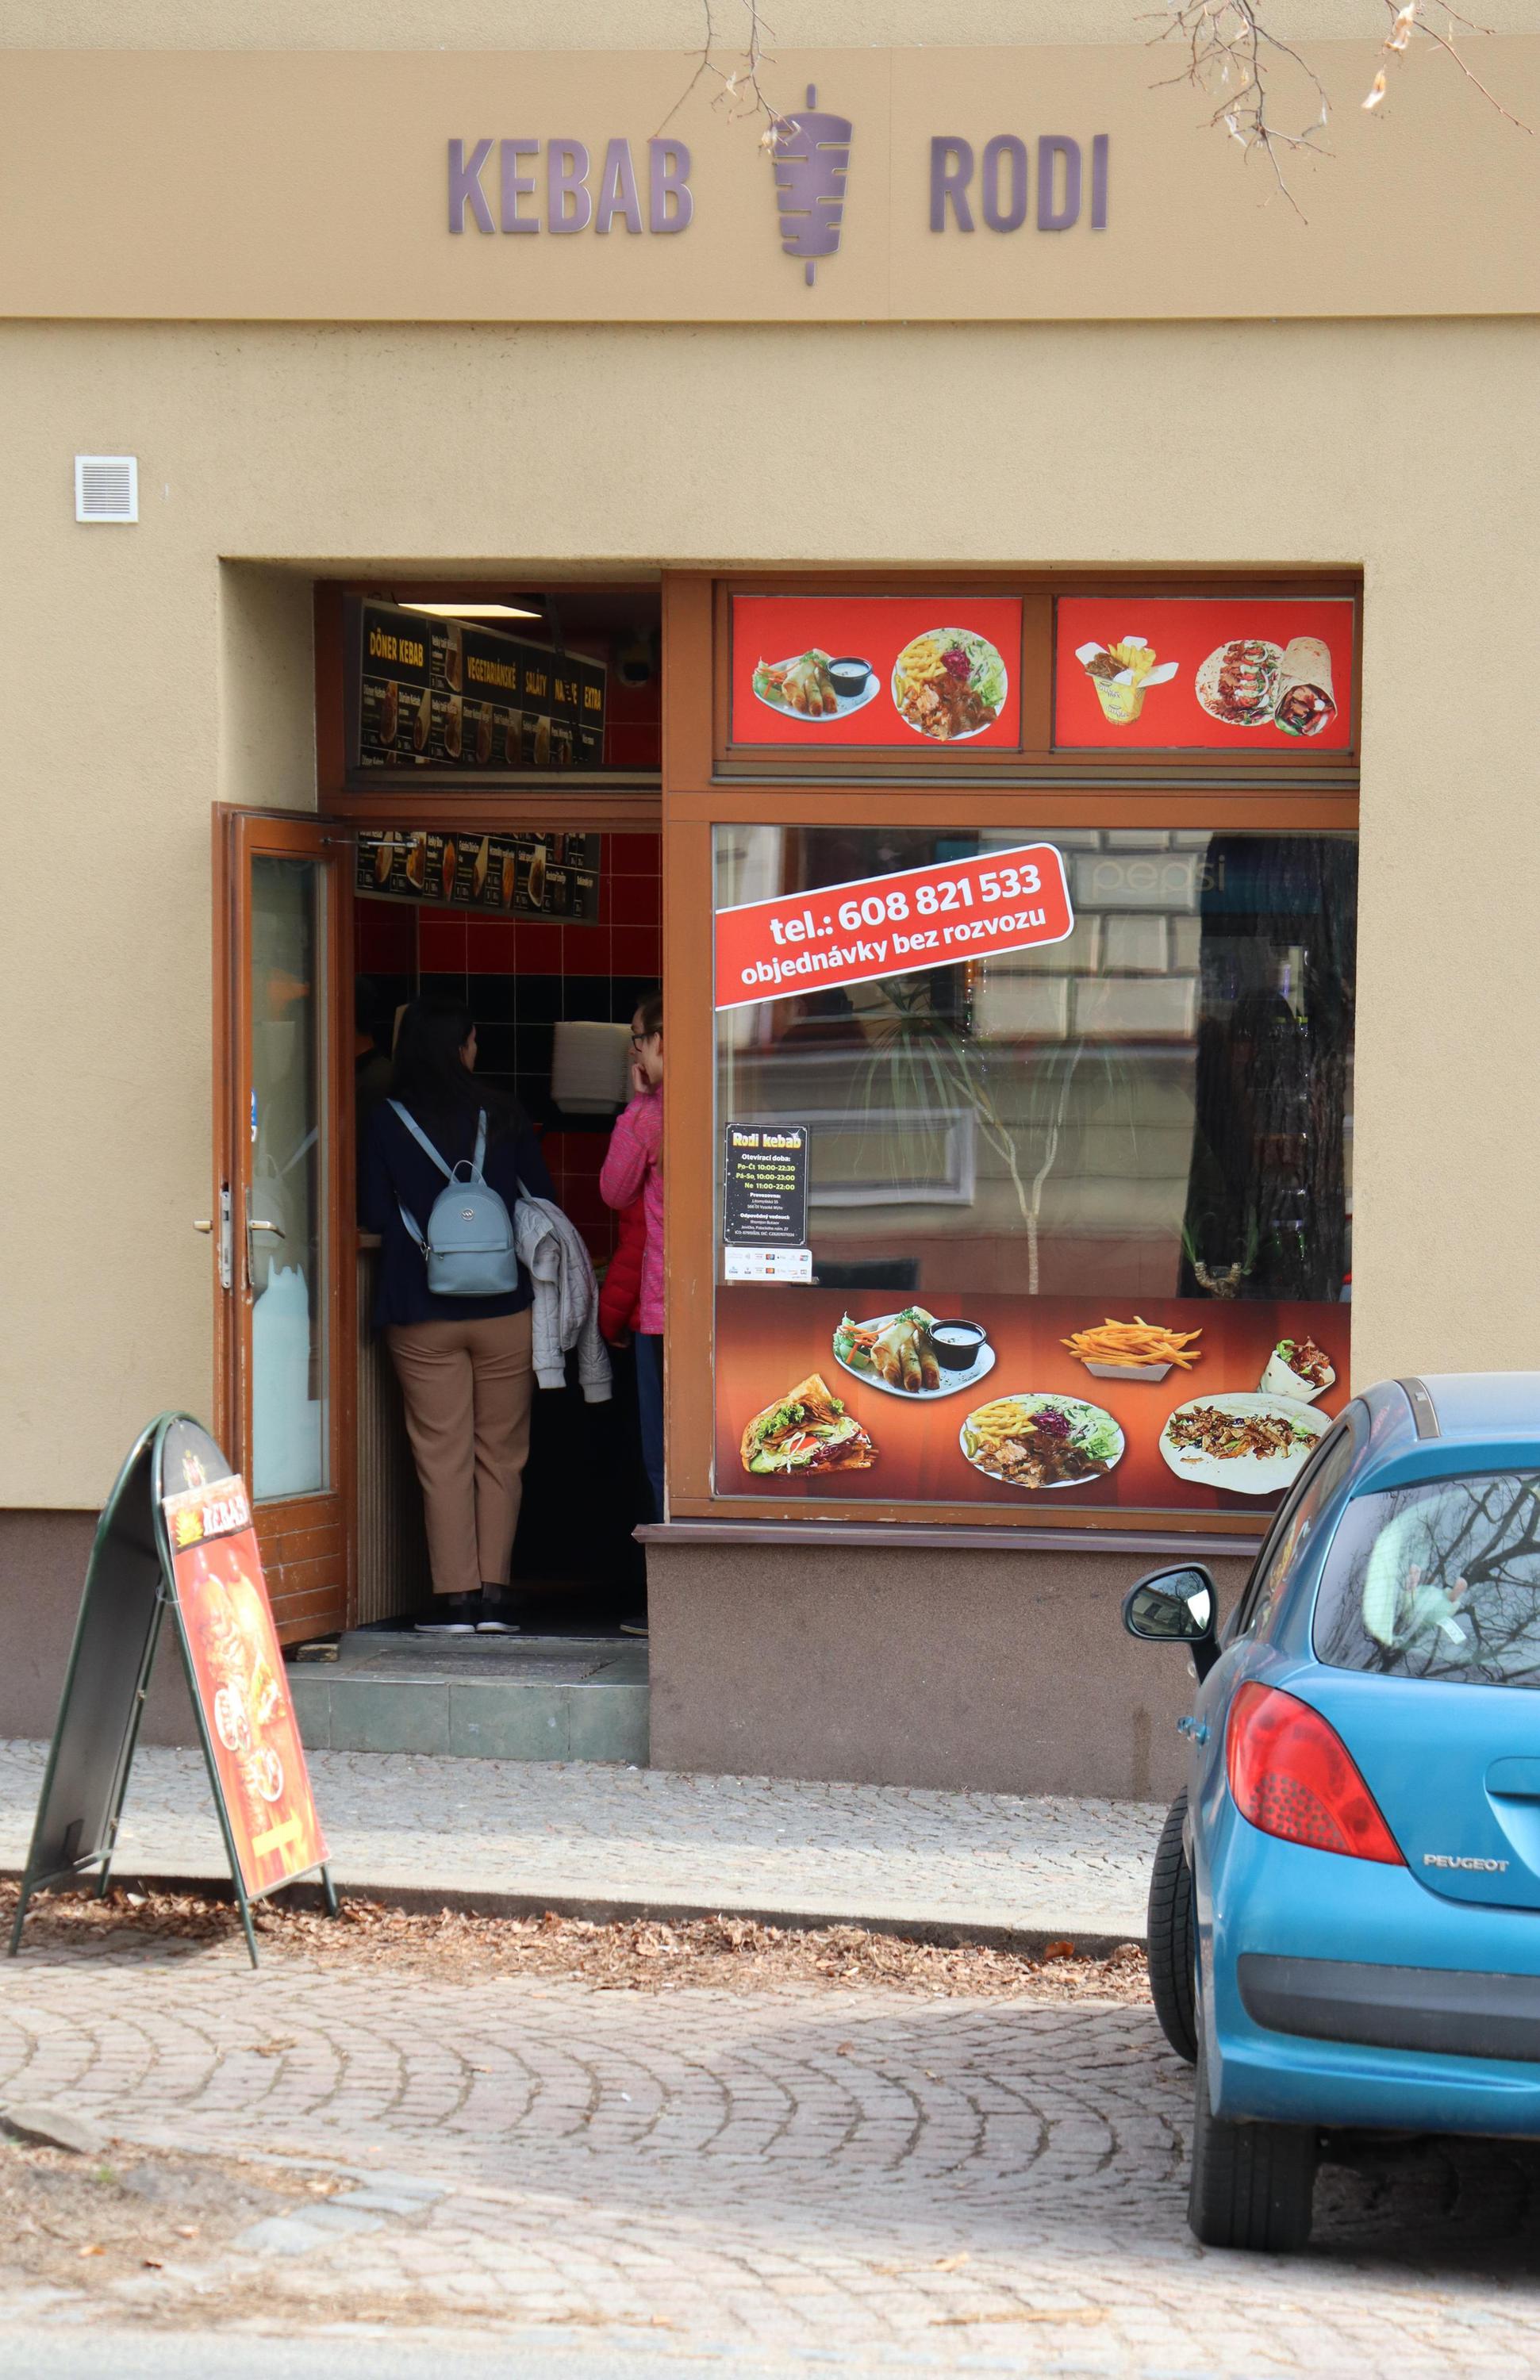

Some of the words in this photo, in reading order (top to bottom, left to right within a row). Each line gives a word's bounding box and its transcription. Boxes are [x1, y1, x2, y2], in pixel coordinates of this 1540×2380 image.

[448, 138, 693, 234] KEBAB
[931, 133, 1109, 232] RODI
[370, 627, 397, 660] DÖNER
[399, 639, 424, 667] KEBAB
[467, 655, 517, 690] VEGETARIÁNSKÉ
[525, 666, 547, 697] SALÁTY
[584, 685, 603, 712] EXTRA
[1093, 854, 1225, 900] pepsi
[770, 910, 833, 945] tel.:
[838, 892, 909, 931] 608
[915, 877, 974, 915] 821
[978, 865, 1042, 902] 533
[741, 938, 888, 985] objednávky
[893, 930, 939, 954] bez
[943, 908, 1046, 945] rozvozu
[732, 1132, 759, 1147] Rodi
[762, 1134, 801, 1149] kebab
[1423, 1853, 1510, 1872] PEUGEOT
